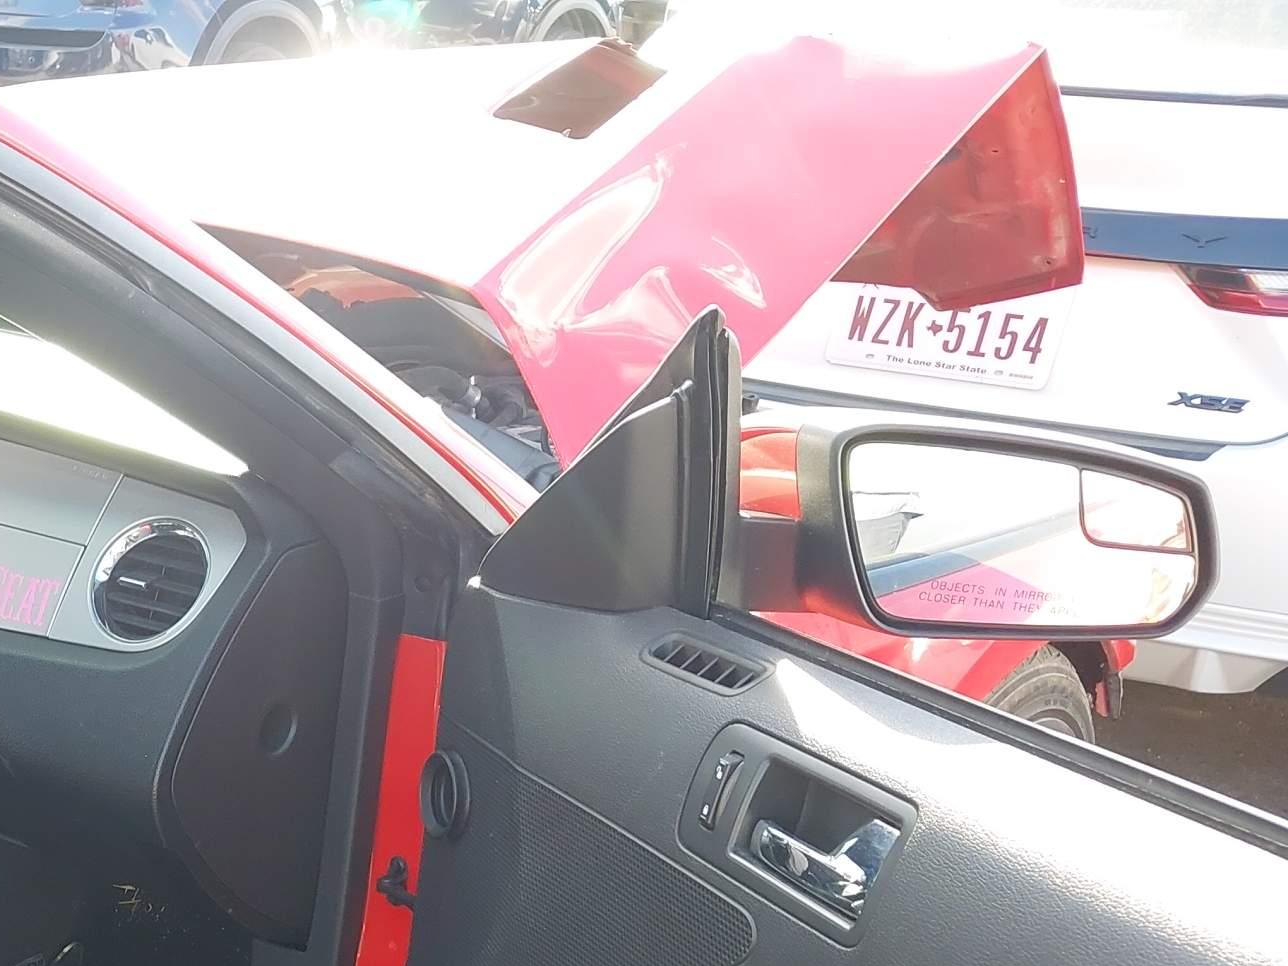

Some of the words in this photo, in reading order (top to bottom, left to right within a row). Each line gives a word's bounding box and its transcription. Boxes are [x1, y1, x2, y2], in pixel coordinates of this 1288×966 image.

[848, 295, 926, 349] WZK
[942, 308, 1049, 365] 5154
[886, 354, 904, 364] The
[907, 357, 932, 368] Lone
[935, 360, 956, 371] Star
[959, 364, 987, 375] State
[930, 580, 985, 596] OBJECTS
[994, 587, 1007, 598] IN
[918, 591, 966, 605] CLOSER
[972, 597, 1005, 610] THAN
